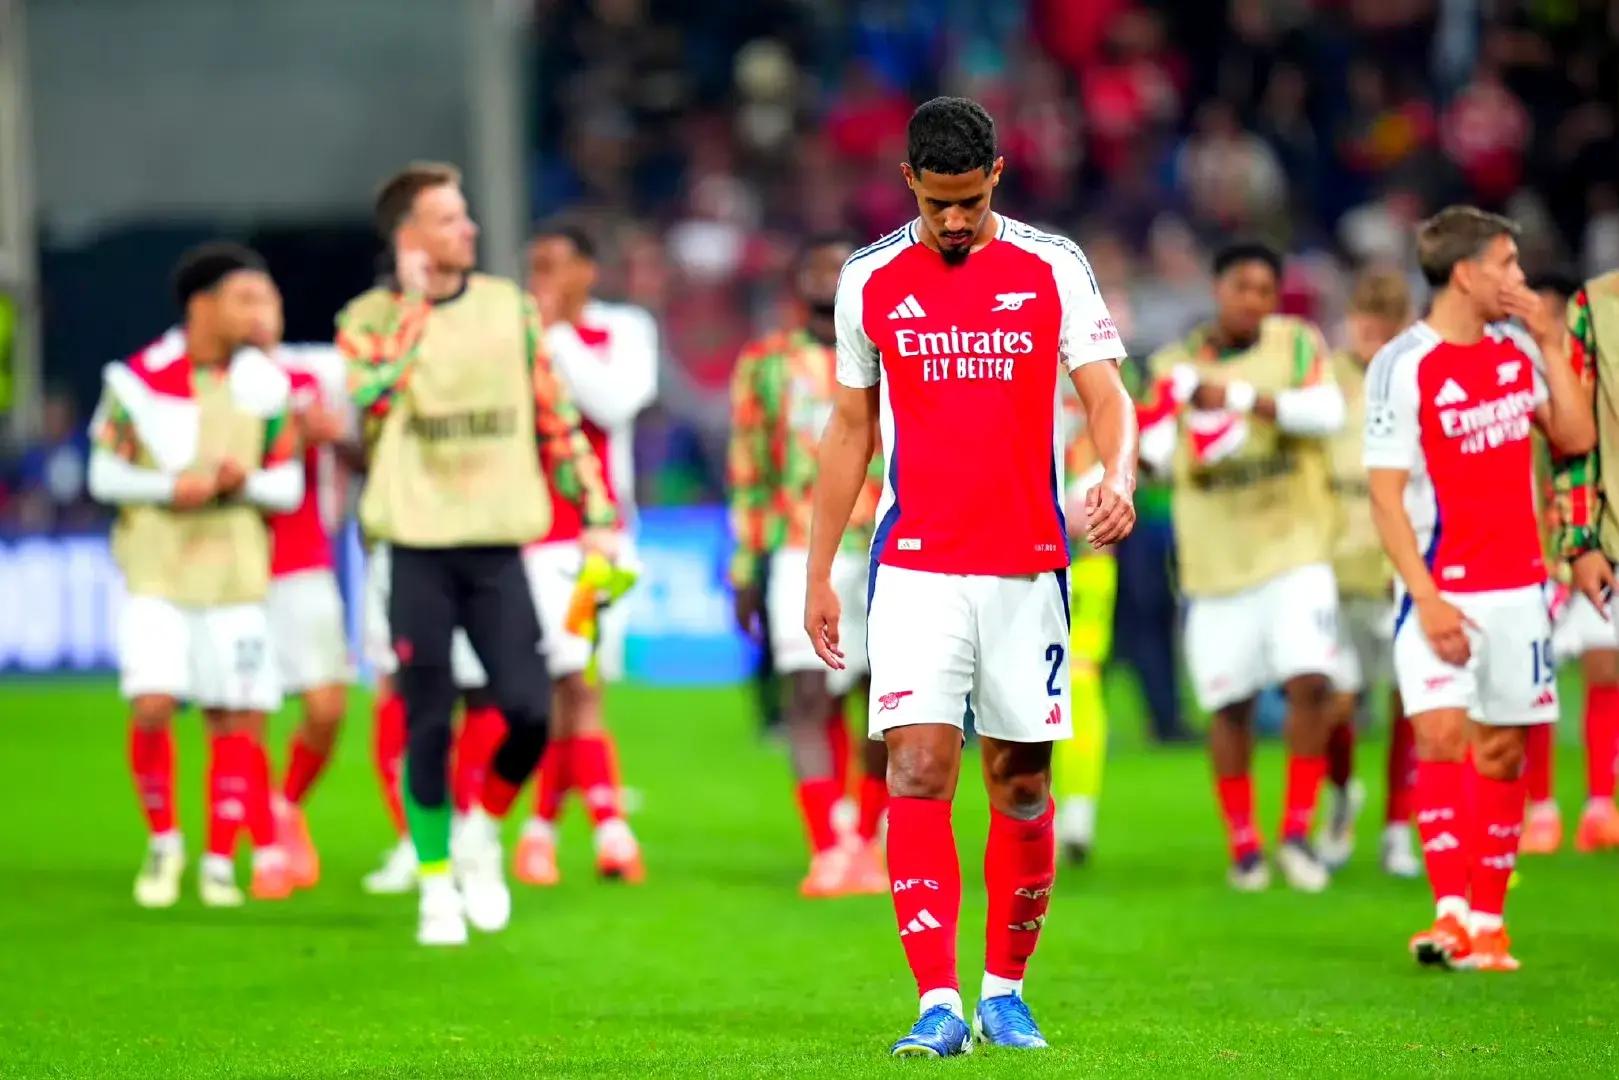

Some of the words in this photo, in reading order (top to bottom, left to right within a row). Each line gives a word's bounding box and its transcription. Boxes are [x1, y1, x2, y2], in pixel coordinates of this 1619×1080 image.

[895, 325, 1033, 357] Emirates
[923, 358, 950, 382] FLY
[956, 357, 1015, 381] BETTER
[1045, 644, 1065, 697] 2
[1531, 638, 1554, 685] 19
[893, 878, 939, 894] AFC
